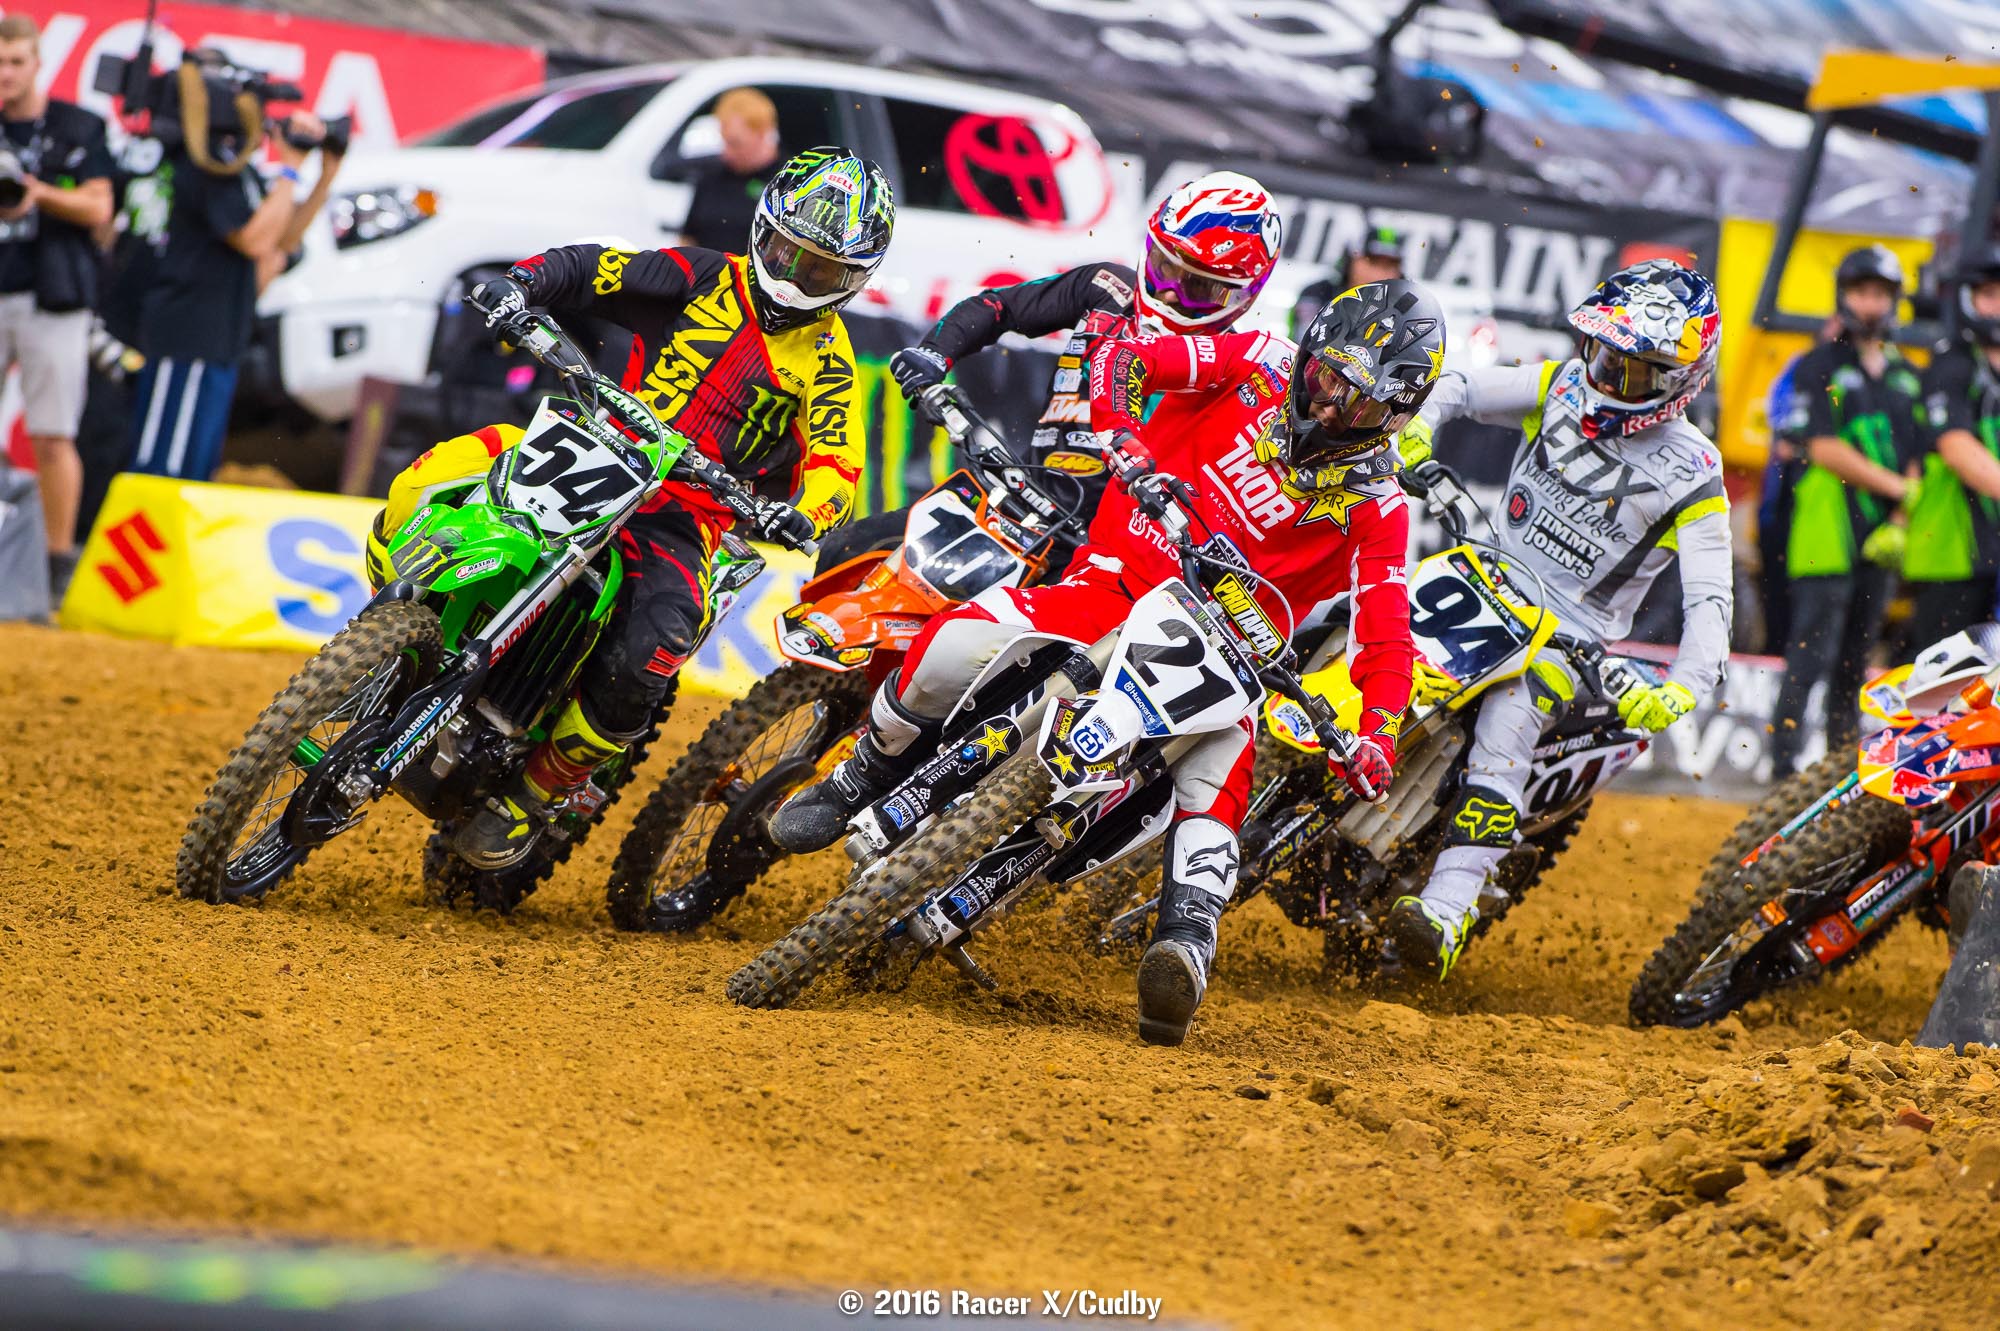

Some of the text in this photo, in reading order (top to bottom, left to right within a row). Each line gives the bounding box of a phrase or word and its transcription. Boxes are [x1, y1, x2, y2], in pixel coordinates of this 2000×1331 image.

[828, 173, 854, 192] BELL
[1176, 188, 1268, 223] FLY
[783, 214, 841, 252] MONSTER
[775, 291, 791, 303] BELL
[1572, 311, 1638, 350] Red Bull
[1093, 339, 1116, 400] sqvarna
[1324, 345, 1377, 387] ROCKSTAR
[809, 352, 854, 451] ANSR
[584, 421, 627, 455] MONSTER
[511, 422, 640, 527] 54
[1543, 413, 1661, 525] FOX
[727, 496, 754, 518] ARC
[1567, 495, 1630, 544] Eagle
[904, 506, 1018, 602] 10
[1523, 526, 1595, 580] JOHN'S
[1533, 508, 1605, 561] JIMMY
[1204, 618, 1239, 665] MOSTER
[1409, 575, 1522, 679] 94
[1125, 618, 1237, 725] 21
[389, 693, 464, 781] DUNLOP
[397, 696, 442, 746] CARRILLO
[925, 759, 960, 786] RADISE
[902, 788, 926, 818] GALFER
[967, 877, 991, 906] GALFER
